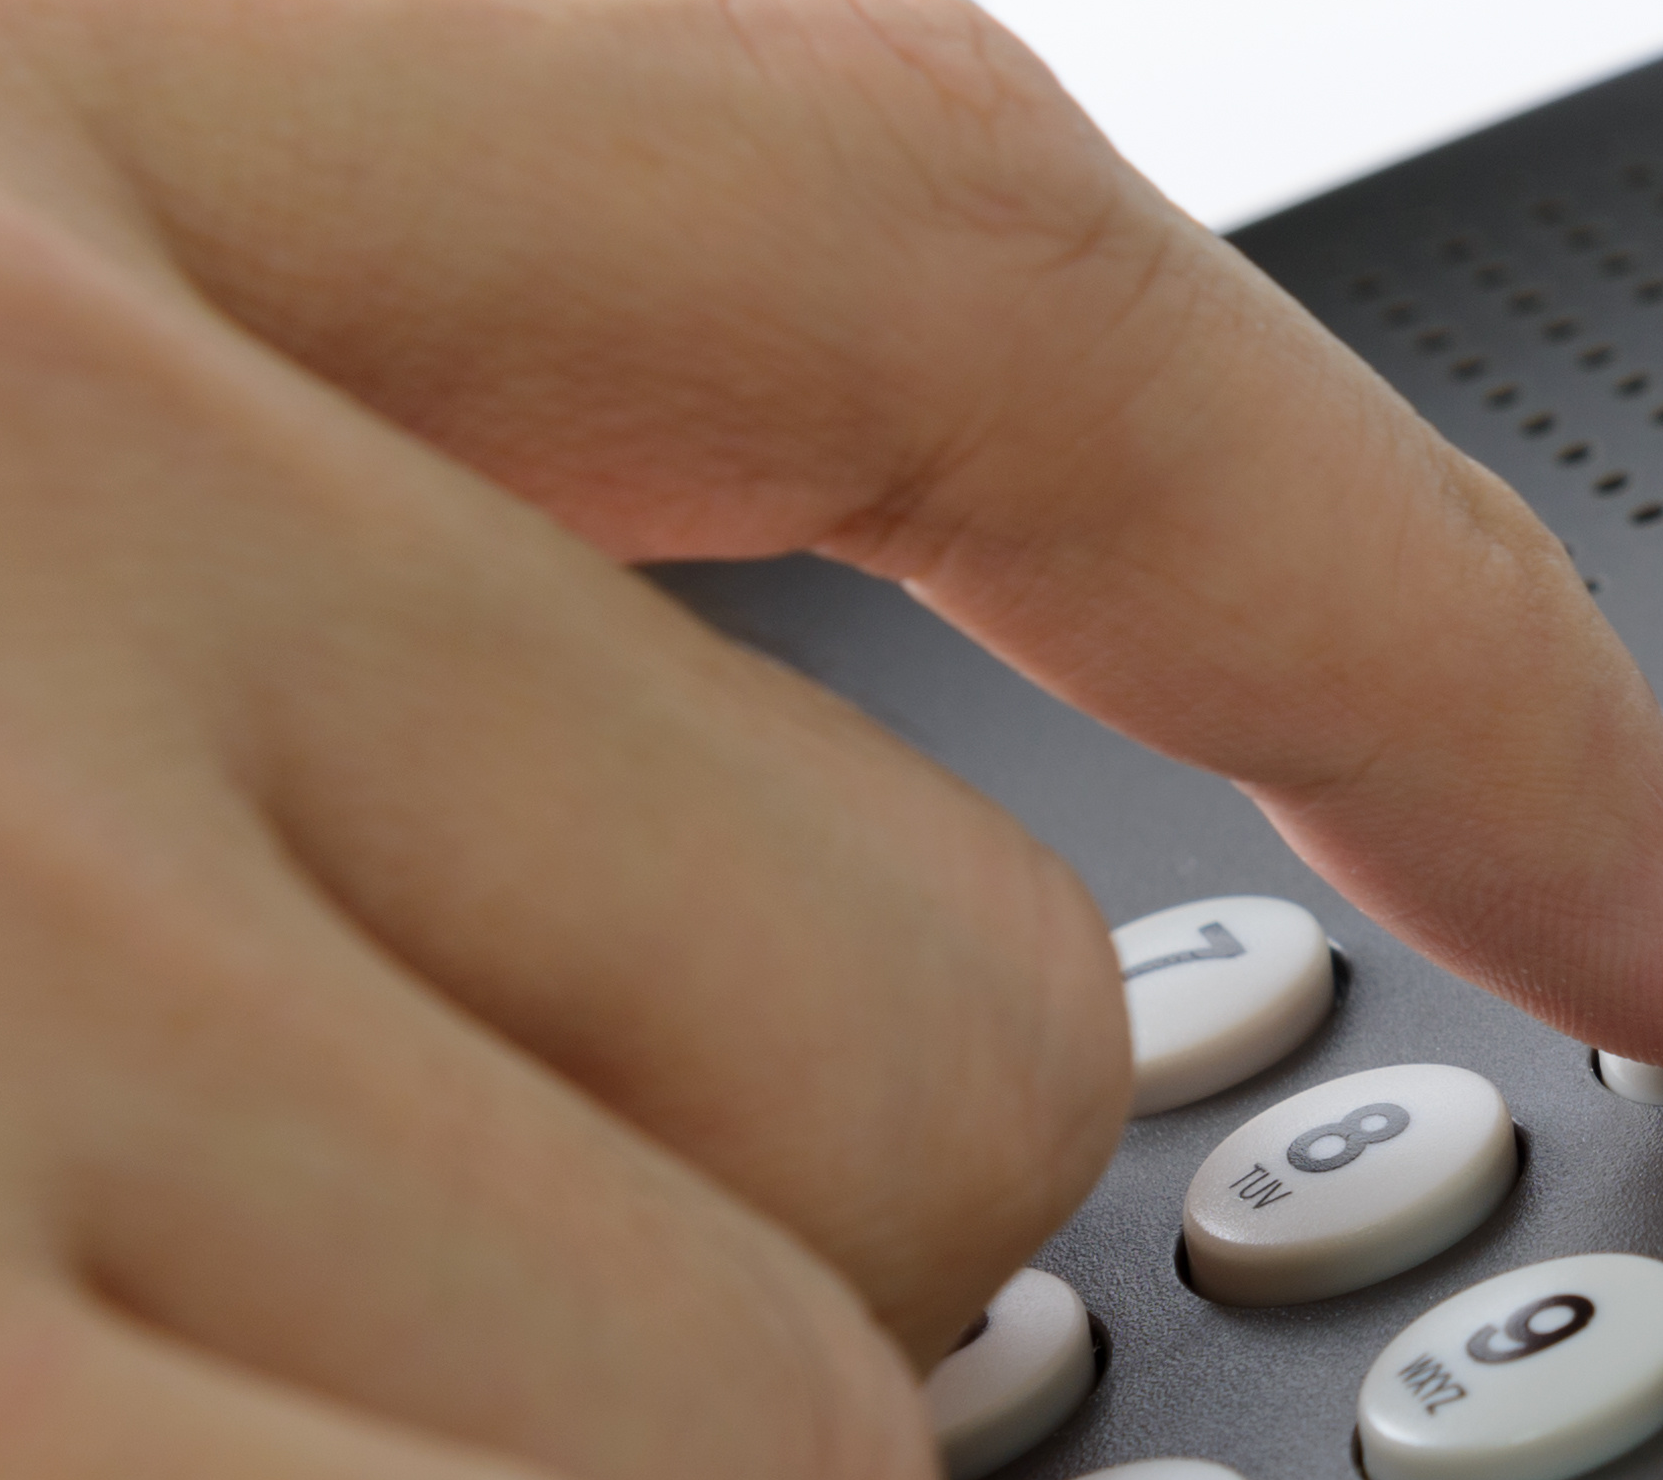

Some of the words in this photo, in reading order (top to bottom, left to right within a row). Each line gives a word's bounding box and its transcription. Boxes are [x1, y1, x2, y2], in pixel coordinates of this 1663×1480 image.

[1121, 921, 1247, 980] 7
[1286, 1102, 1411, 1174] 8
[1228, 1163, 1292, 1211] TUV
[1466, 1293, 1596, 1365] 9
[1396, 1352, 1468, 1417] WXYZ
